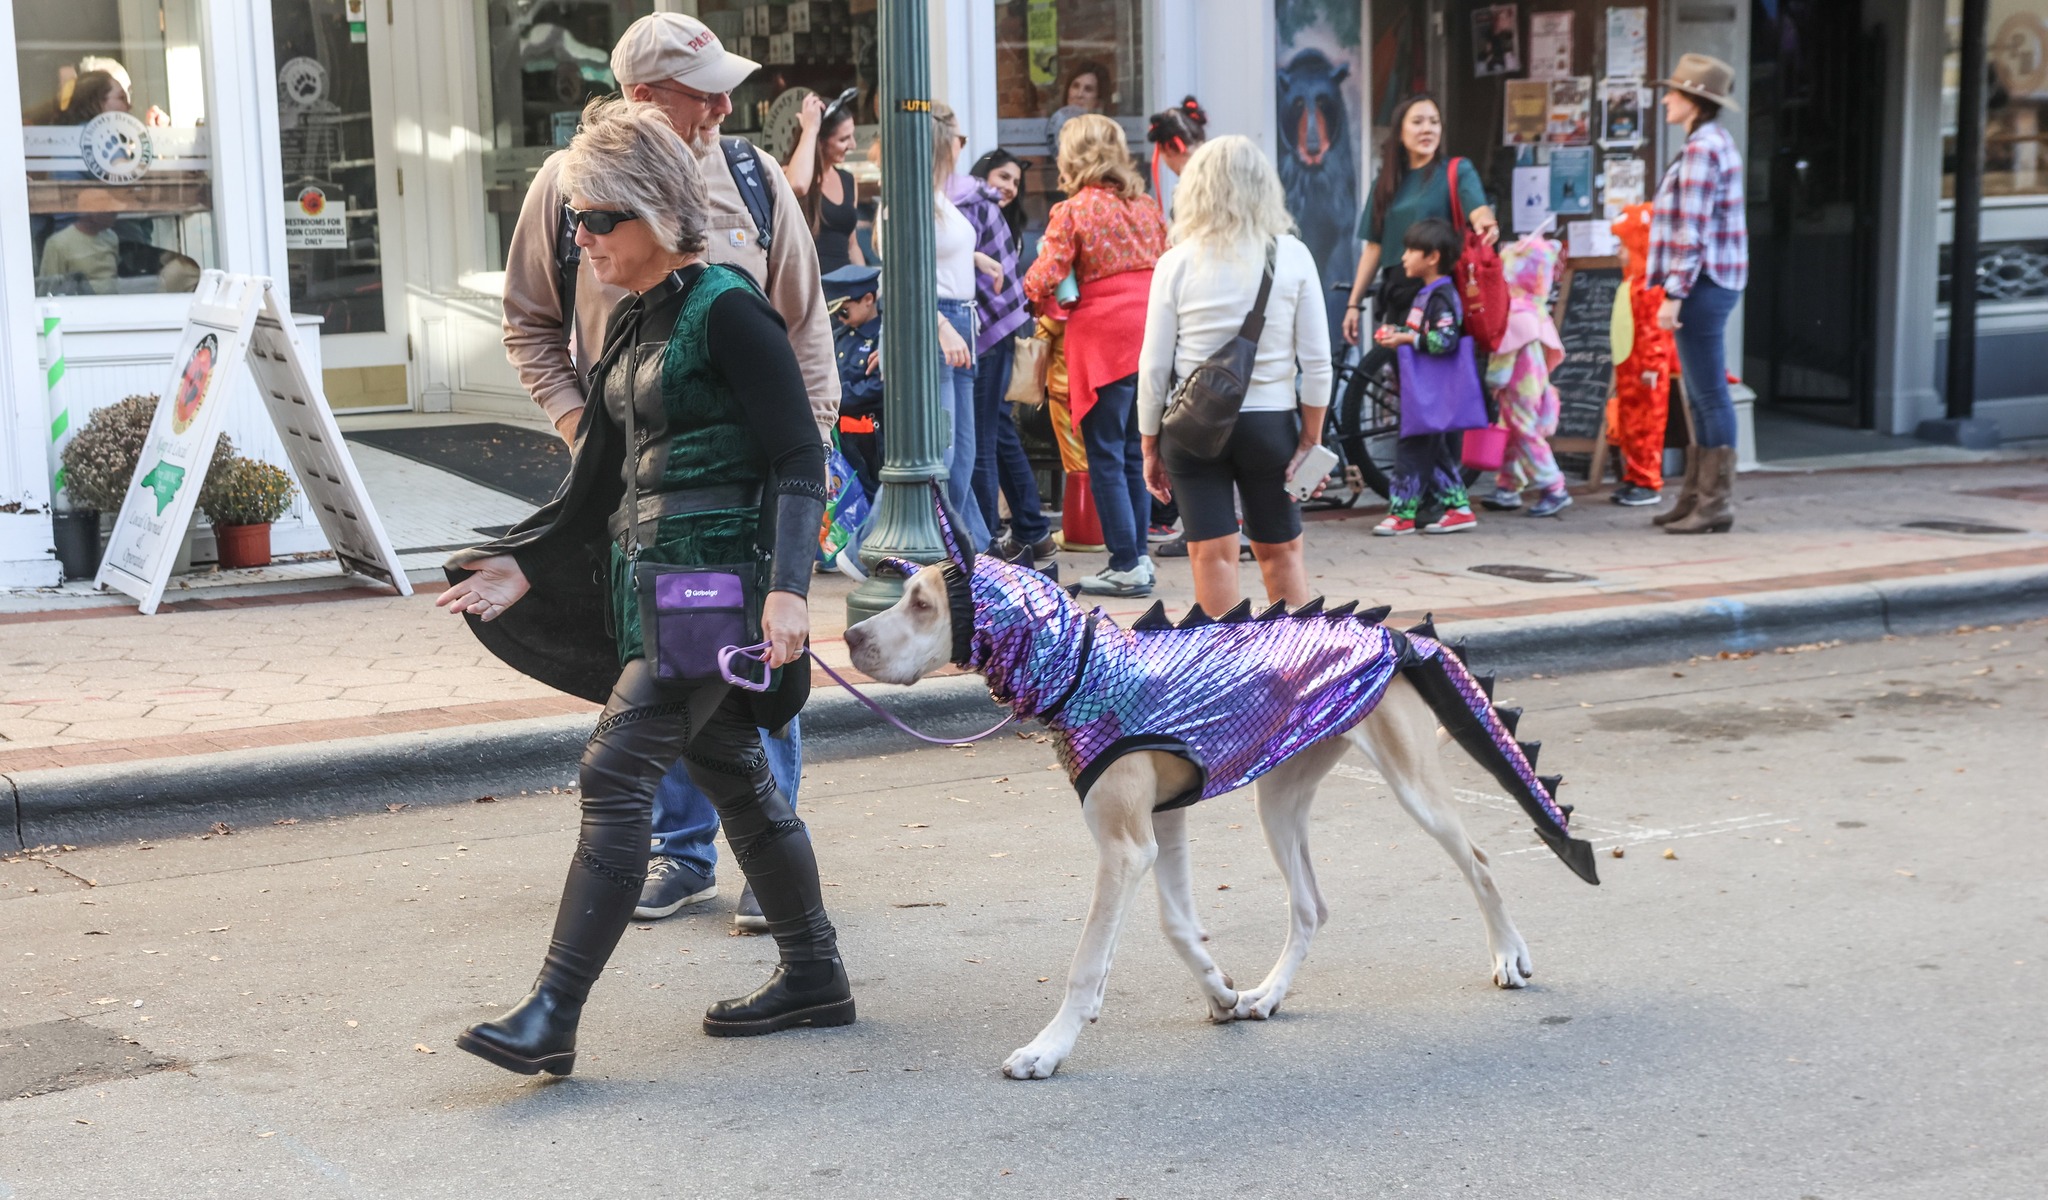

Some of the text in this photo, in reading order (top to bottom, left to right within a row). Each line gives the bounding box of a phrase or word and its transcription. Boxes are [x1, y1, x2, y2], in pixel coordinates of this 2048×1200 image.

[764, 94, 793, 142] Thirsty
[83, 115, 111, 143] Thirsty
[285, 218, 341, 226] RESTROOMS FOR
[286, 228, 345, 236] RUIN CUSTOMERS
[304, 238, 322, 246] ONLY
